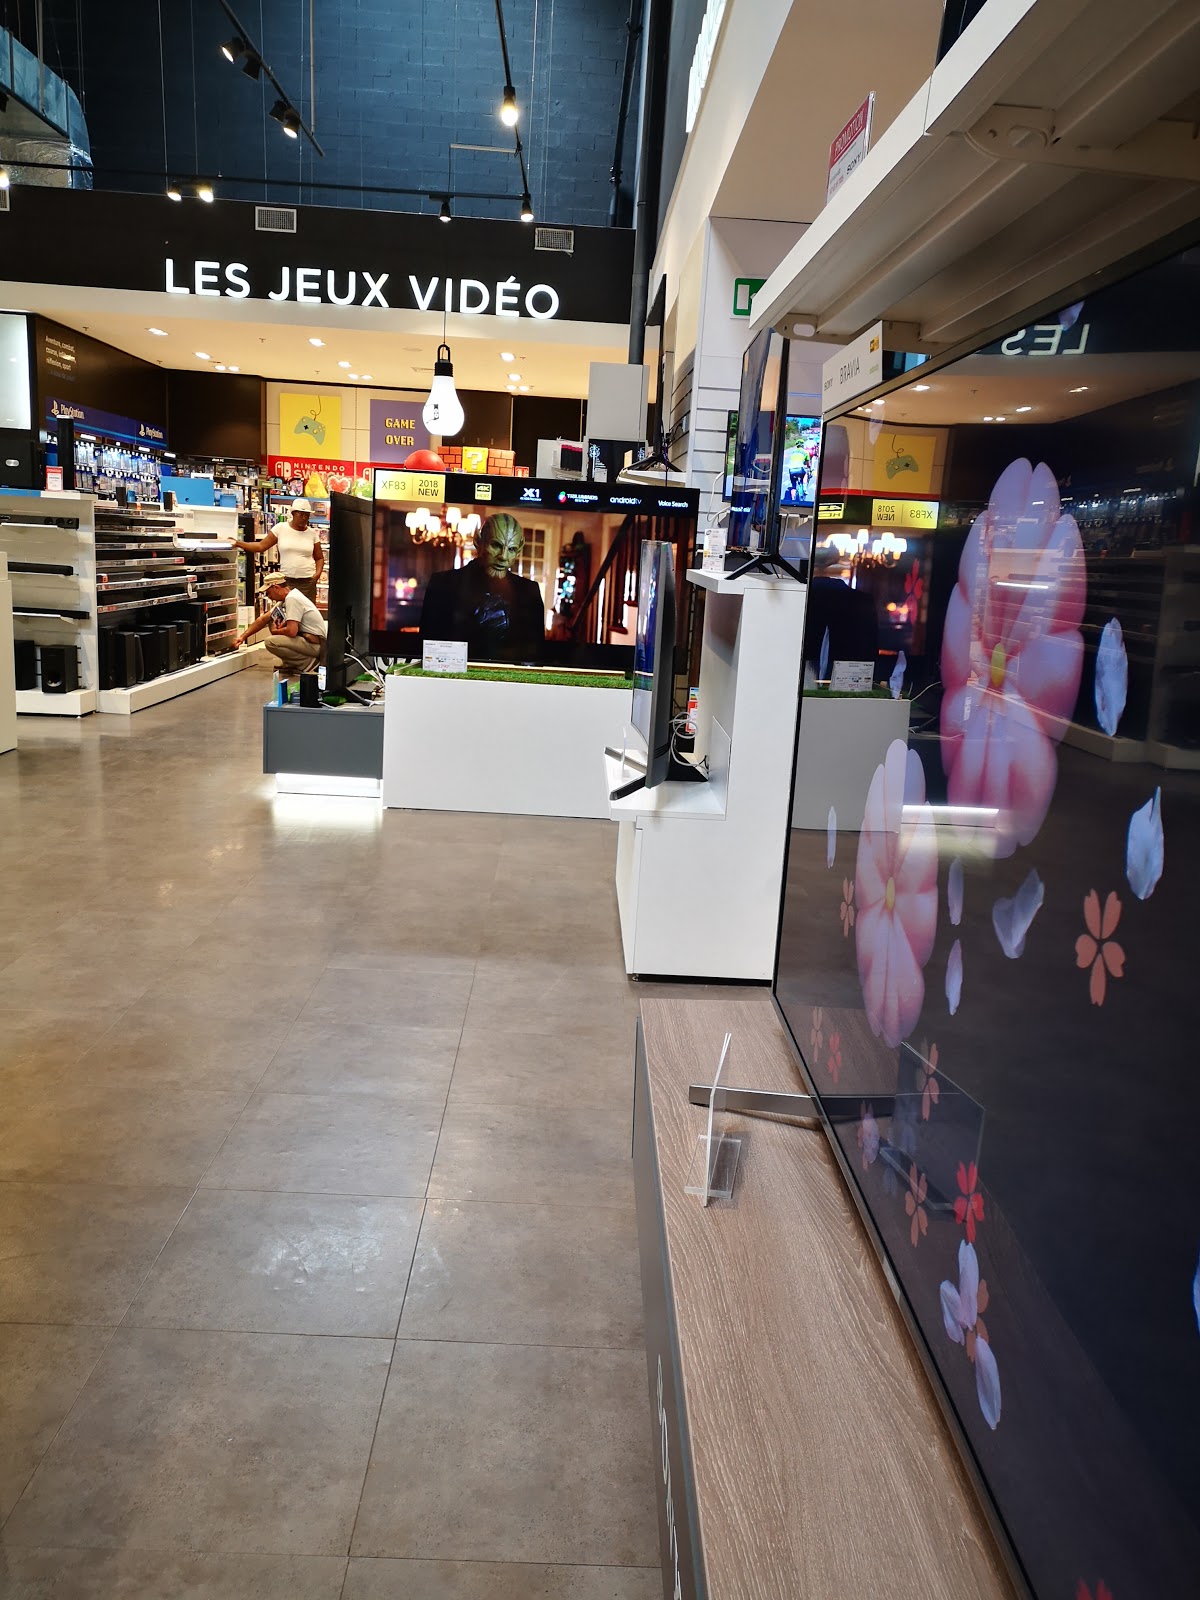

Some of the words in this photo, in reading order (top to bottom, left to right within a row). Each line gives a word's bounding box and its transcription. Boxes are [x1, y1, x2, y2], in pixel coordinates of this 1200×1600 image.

[165, 258, 251, 298] LES
[268, 266, 389, 308] JEUX
[408, 275, 559, 320] VIDÉO
[839, 356, 860, 385] BRAVIA
[60, 404, 85, 419] PlayStation
[385, 417, 416, 429] GAME
[145, 426, 163, 440] PlayStation
[385, 434, 414, 446] OVER
[293, 462, 346, 472] NINTENDO
[381, 480, 406, 490] XF83
[419, 479, 438, 488] 2018
[418, 488, 439, 497] NEW
[523, 488, 540, 498] X1
